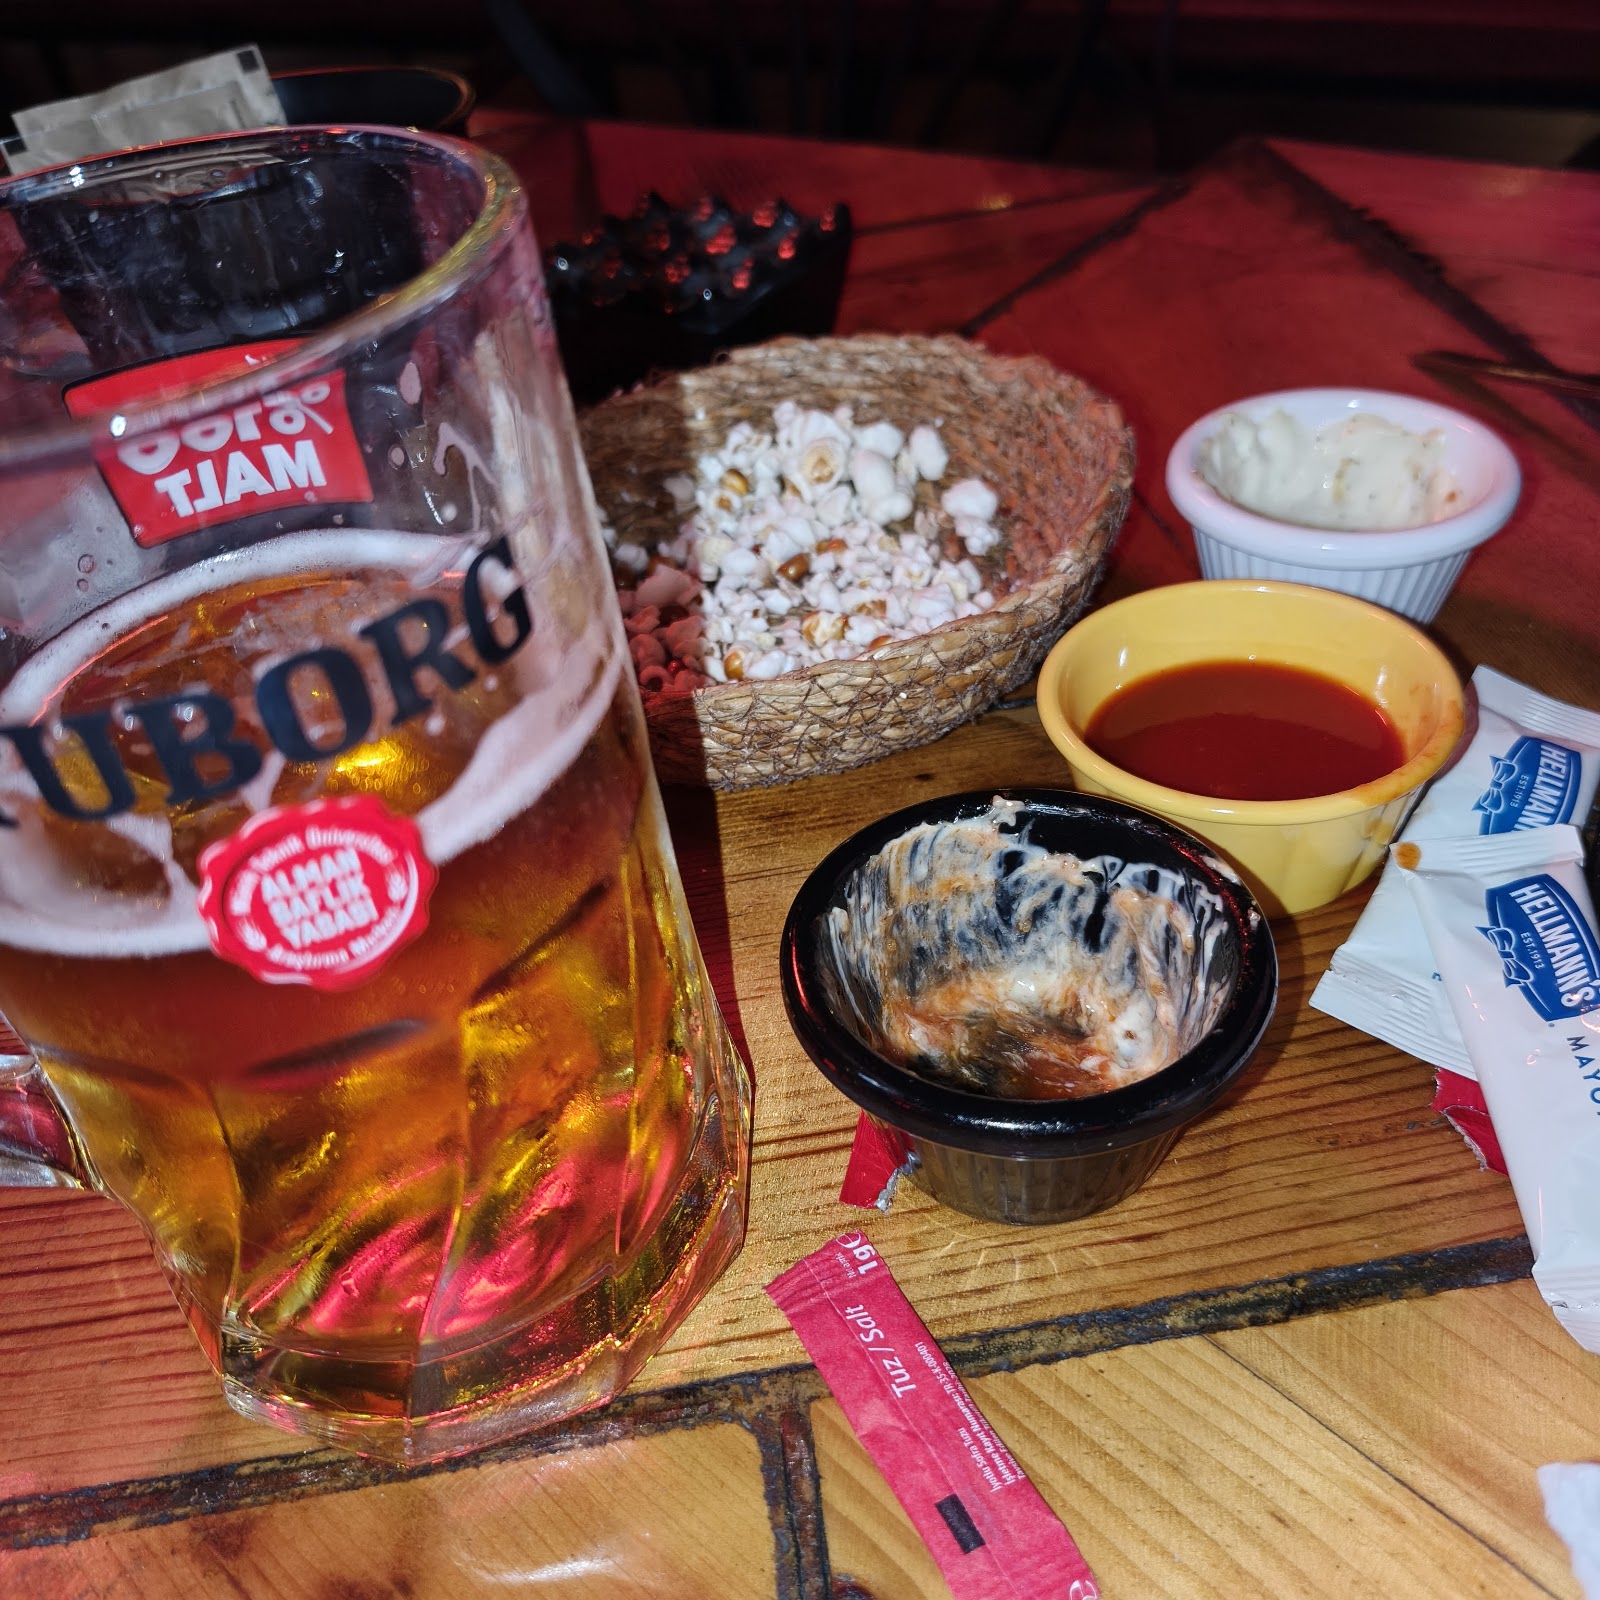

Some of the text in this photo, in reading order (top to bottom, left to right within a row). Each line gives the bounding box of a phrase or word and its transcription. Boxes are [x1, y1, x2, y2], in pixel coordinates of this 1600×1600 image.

[0, 536, 533, 828] UBORG
[261, 848, 361, 905] ALMAN
[845, 1303, 885, 1343] Salt
[882, 1356, 917, 1398] Tuz
